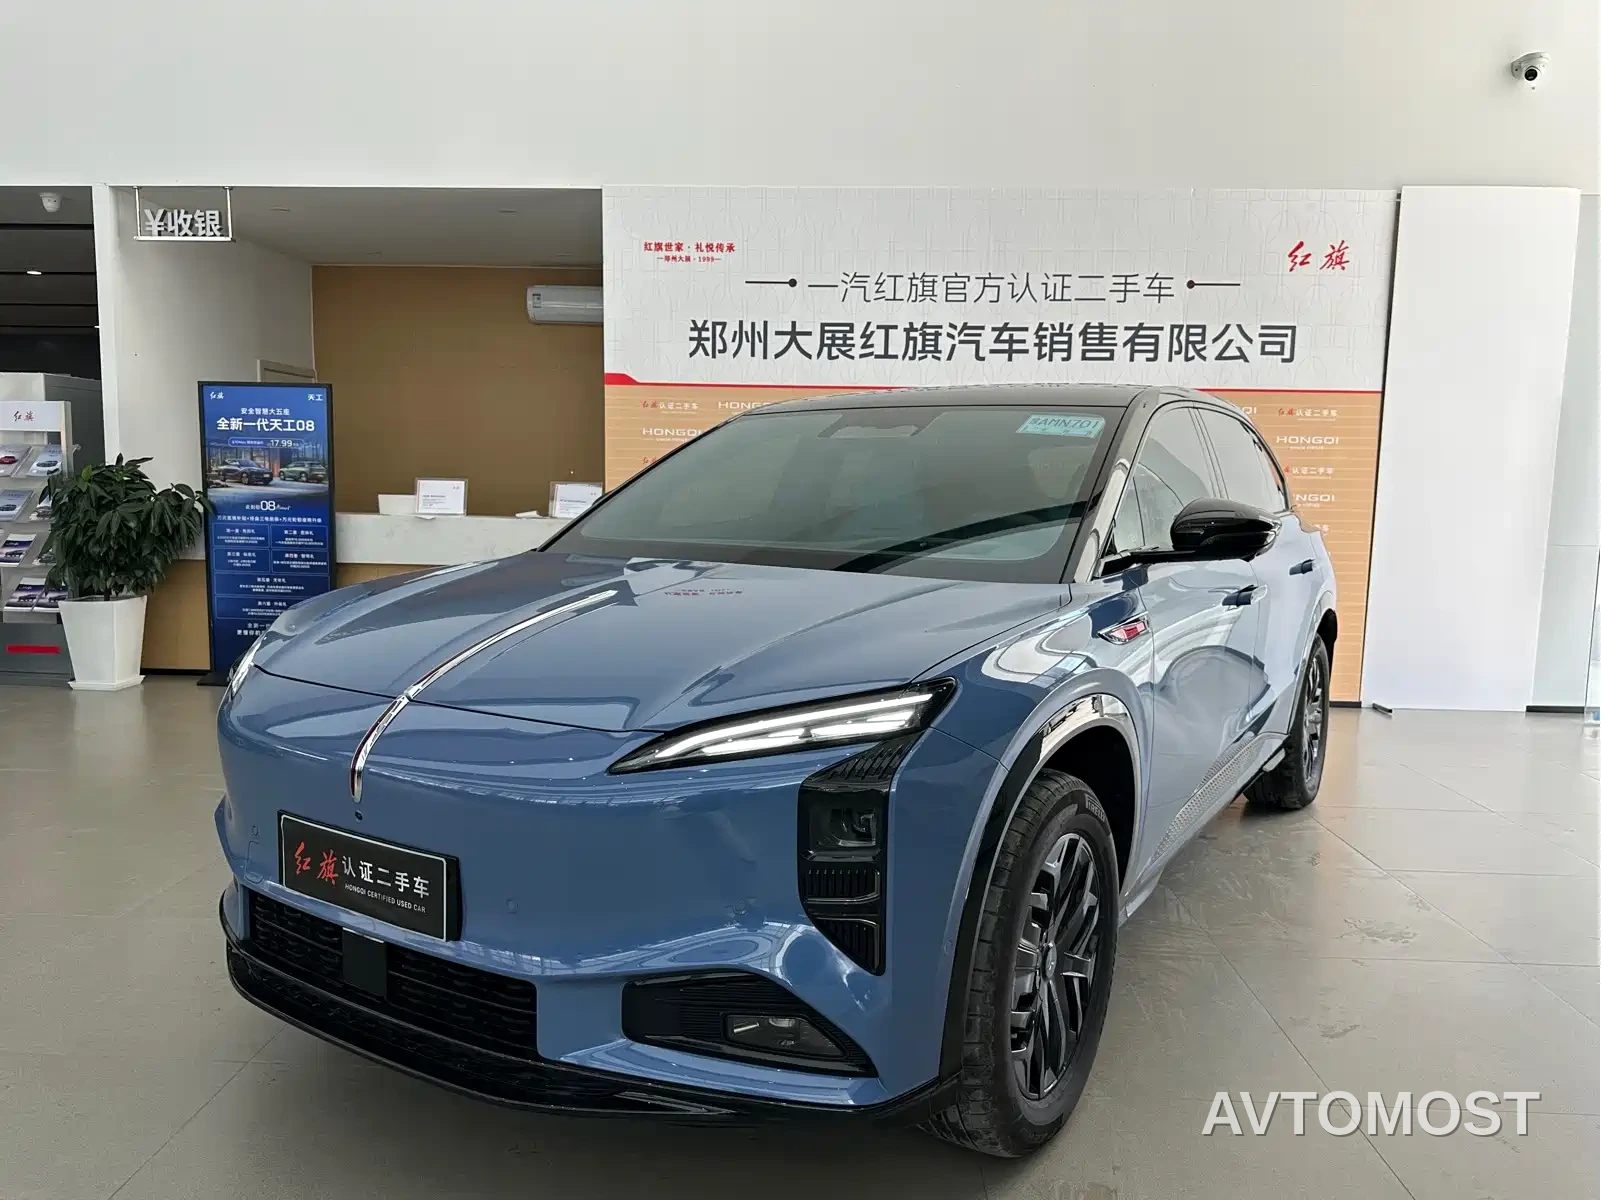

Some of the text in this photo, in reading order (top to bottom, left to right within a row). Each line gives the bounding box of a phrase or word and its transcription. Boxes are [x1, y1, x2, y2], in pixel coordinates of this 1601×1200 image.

[143, 208, 222, 237] ¥收银
[1287, 240, 1350, 272] 红旗
[808, 271, 1175, 304] 一汽红旗官方认证二手车
[688, 319, 1297, 364] 郑州大展红旗汽车销售有限公司
[216, 417, 315, 431] 全新一代天工08
[344, 883, 426, 913] HONGQI CERTIFIED USED CAR
